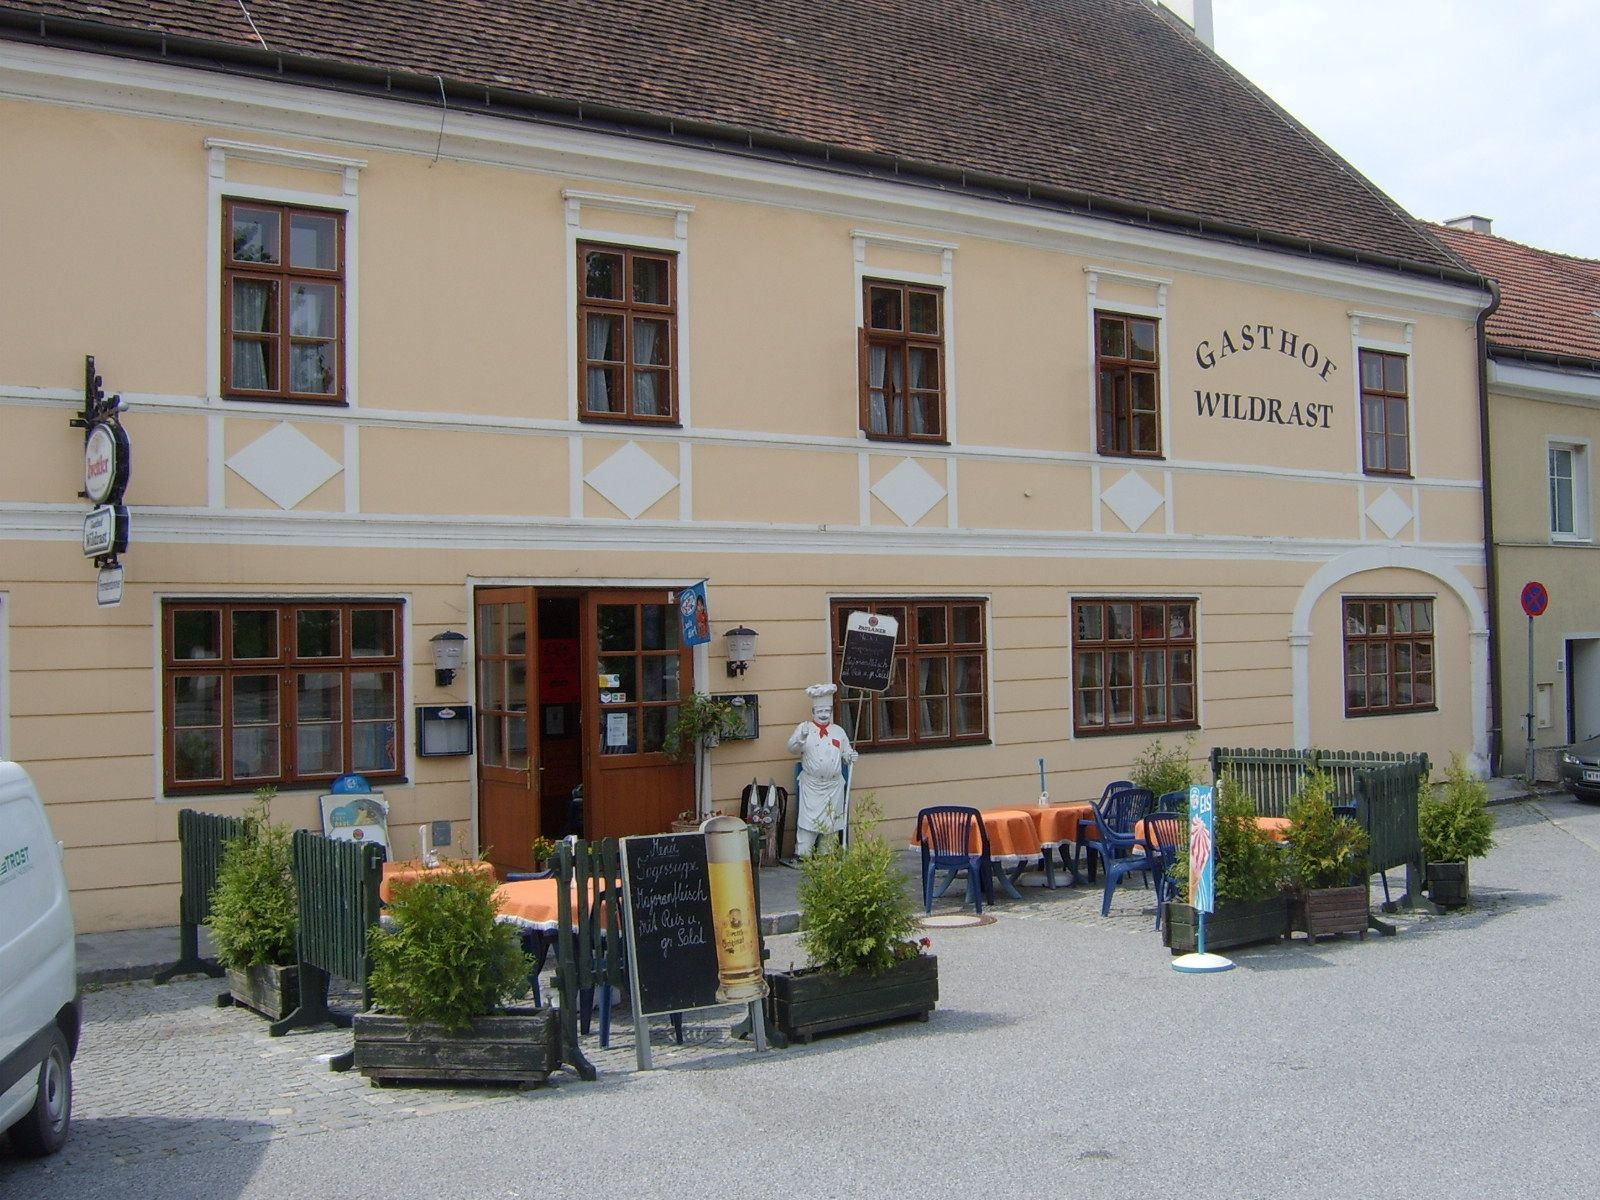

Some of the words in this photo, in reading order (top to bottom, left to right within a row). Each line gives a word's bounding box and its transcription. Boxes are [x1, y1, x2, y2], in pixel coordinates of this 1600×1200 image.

[1196, 324, 1337, 382] GASTHOF
[1194, 390, 1333, 428] WILDRAST
[1200, 792, 1212, 813] EIS
